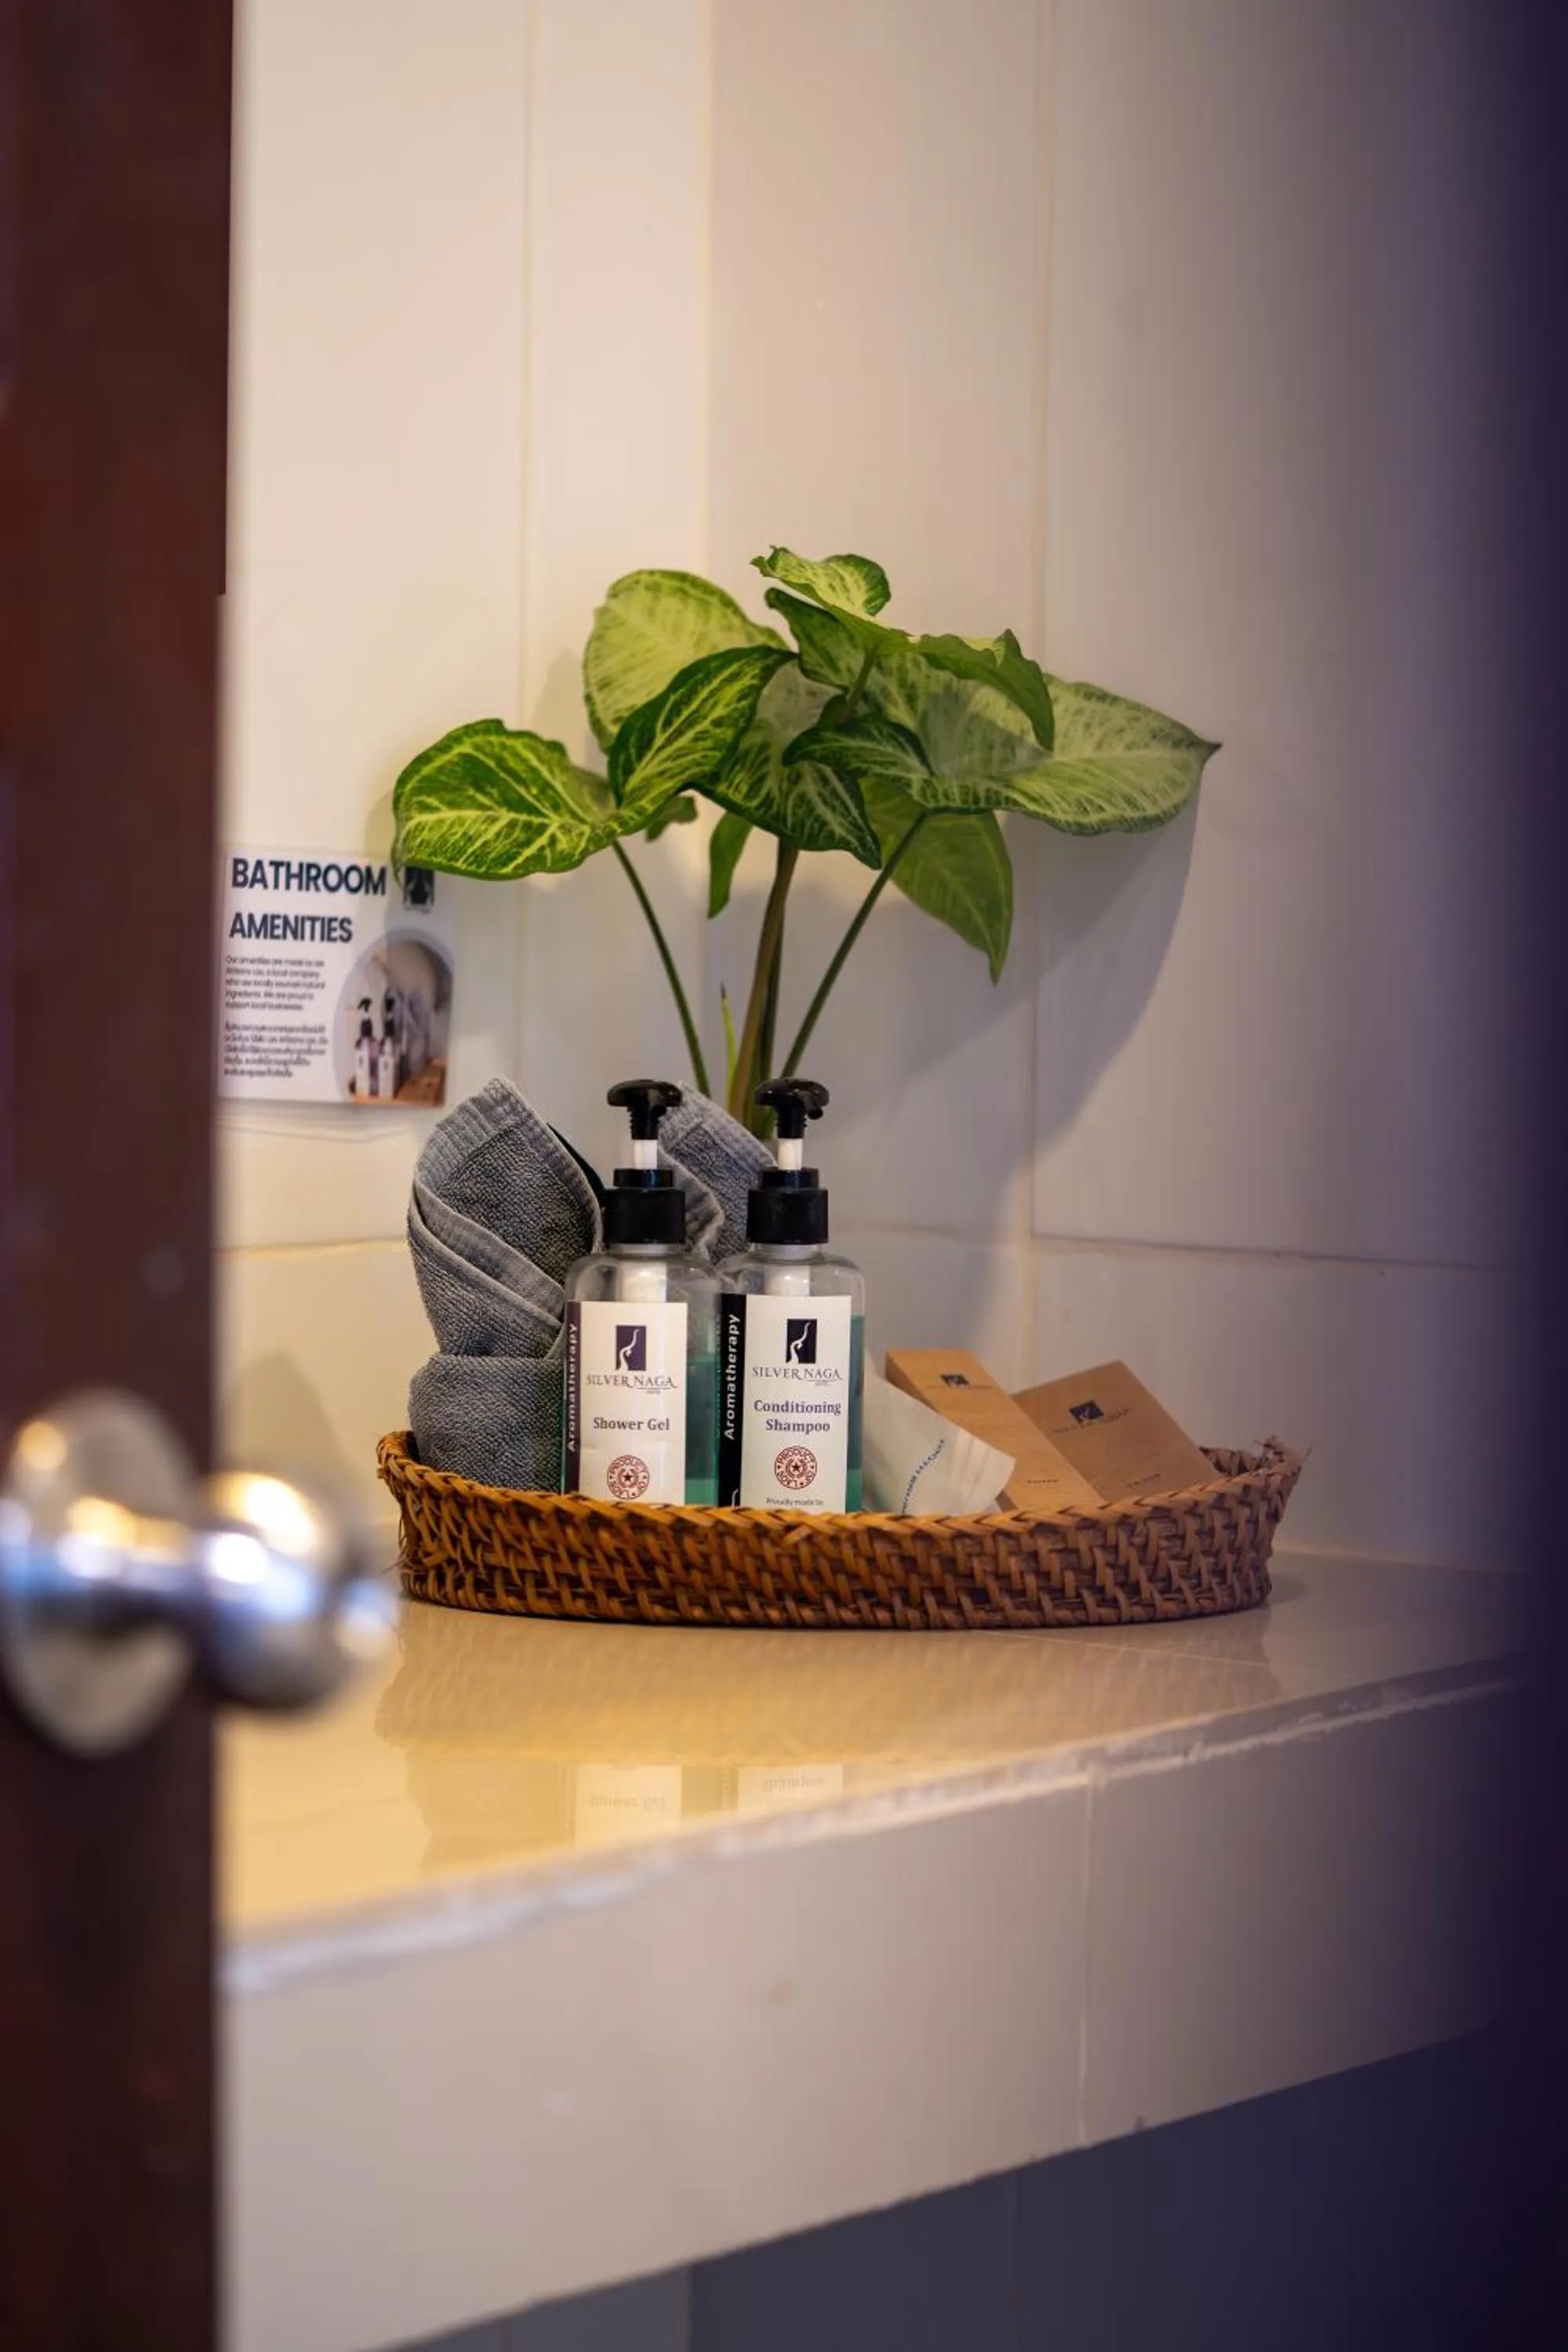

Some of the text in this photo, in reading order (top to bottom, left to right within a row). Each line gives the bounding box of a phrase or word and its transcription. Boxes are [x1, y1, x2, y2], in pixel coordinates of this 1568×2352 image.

[231, 858, 387, 896] BATHROOM
[229, 912, 353, 944] AMENITIES
[586, 1374, 678, 1388] SILVER NAGA
[724, 1314, 741, 1440] Aromatherapy
[752, 1367, 844, 1381] SILVER NAGA
[567, 1323, 579, 1452] Aromatherapy
[753, 1399, 842, 1416] Conditioning
[593, 1417, 670, 1431] Shower Gel
[765, 1419, 831, 1436] Shampoo
